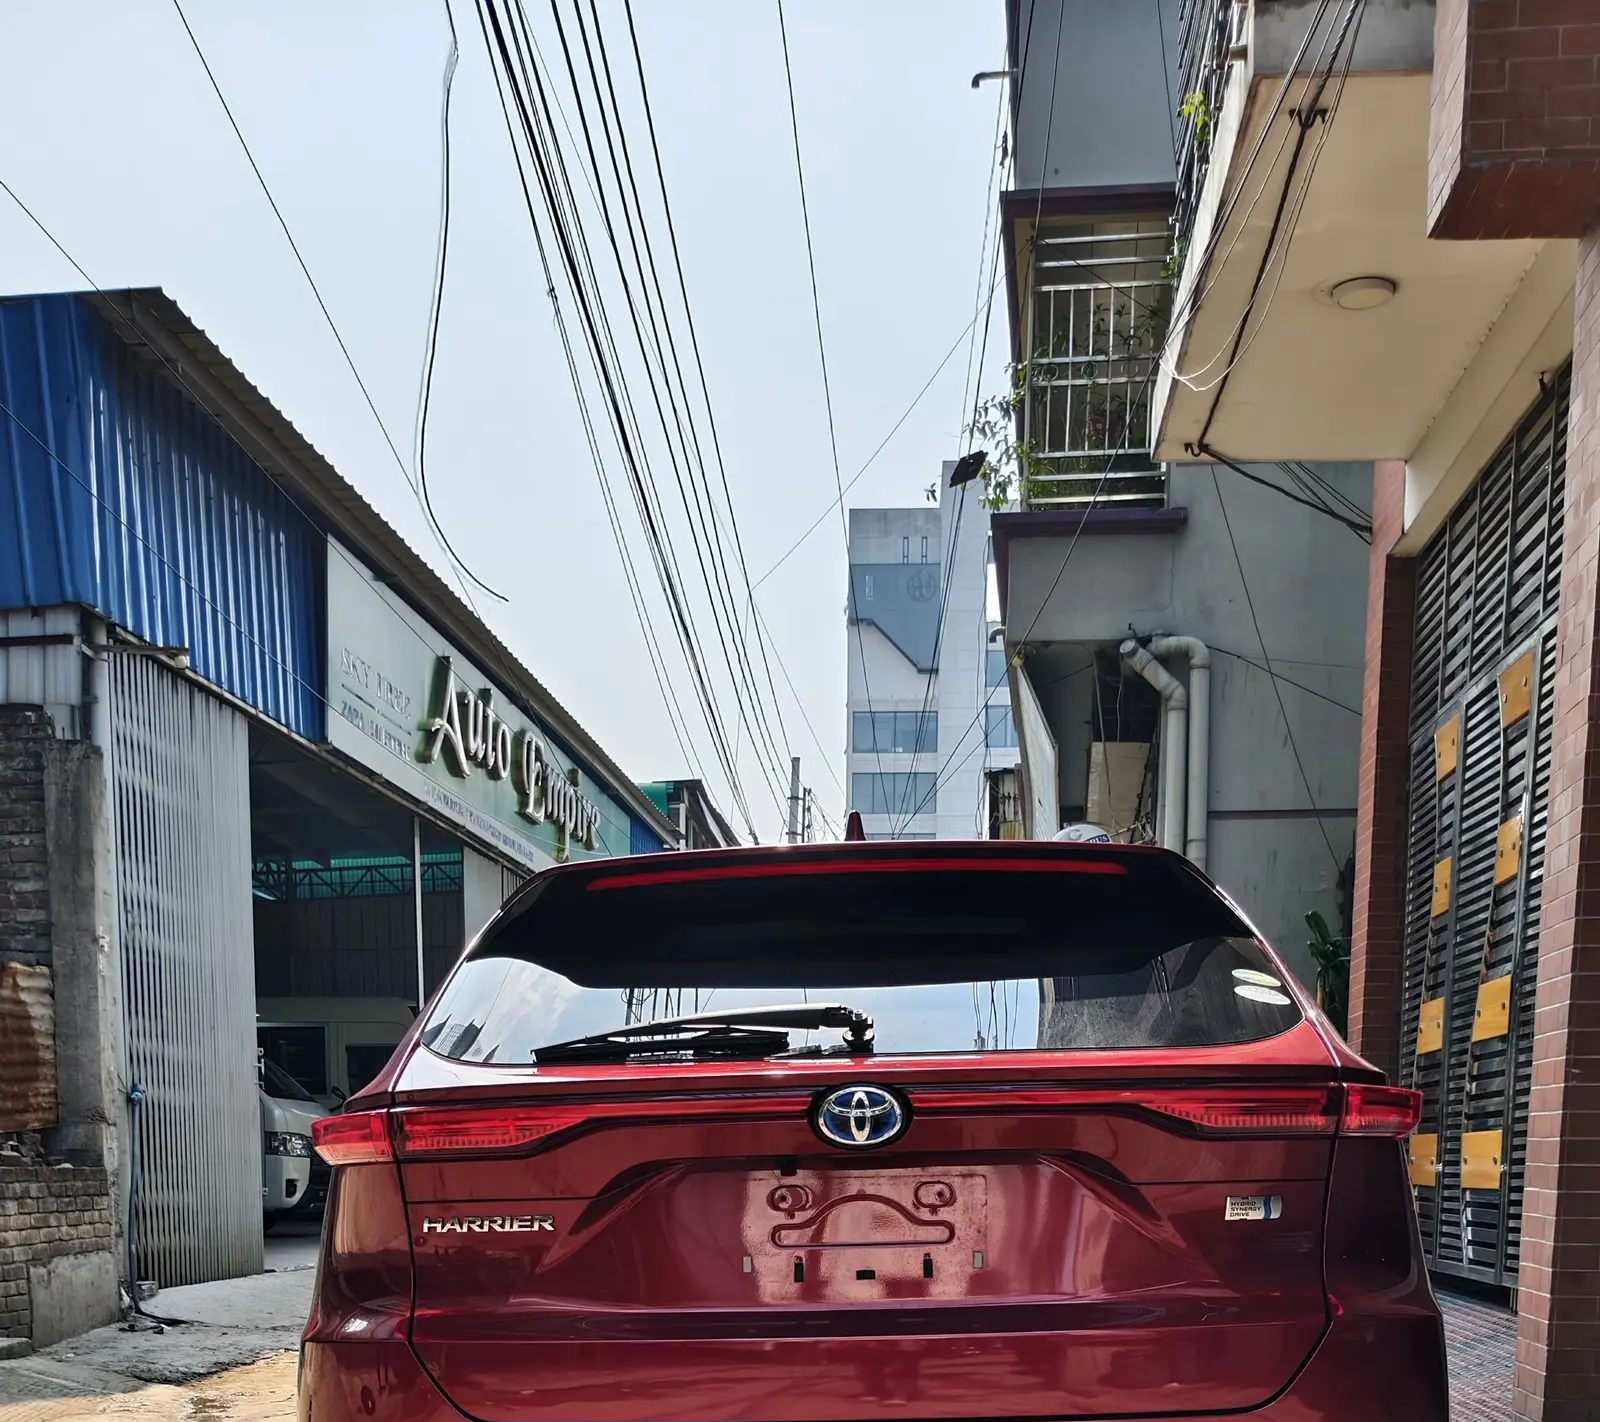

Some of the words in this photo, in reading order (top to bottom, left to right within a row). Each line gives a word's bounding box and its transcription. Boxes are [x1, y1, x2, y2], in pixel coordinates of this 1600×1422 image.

[340, 647, 371, 689] SKY
[424, 655, 511, 781] Auto
[526, 728, 600, 863] Empire
[423, 1215, 555, 1233] HARRIER
